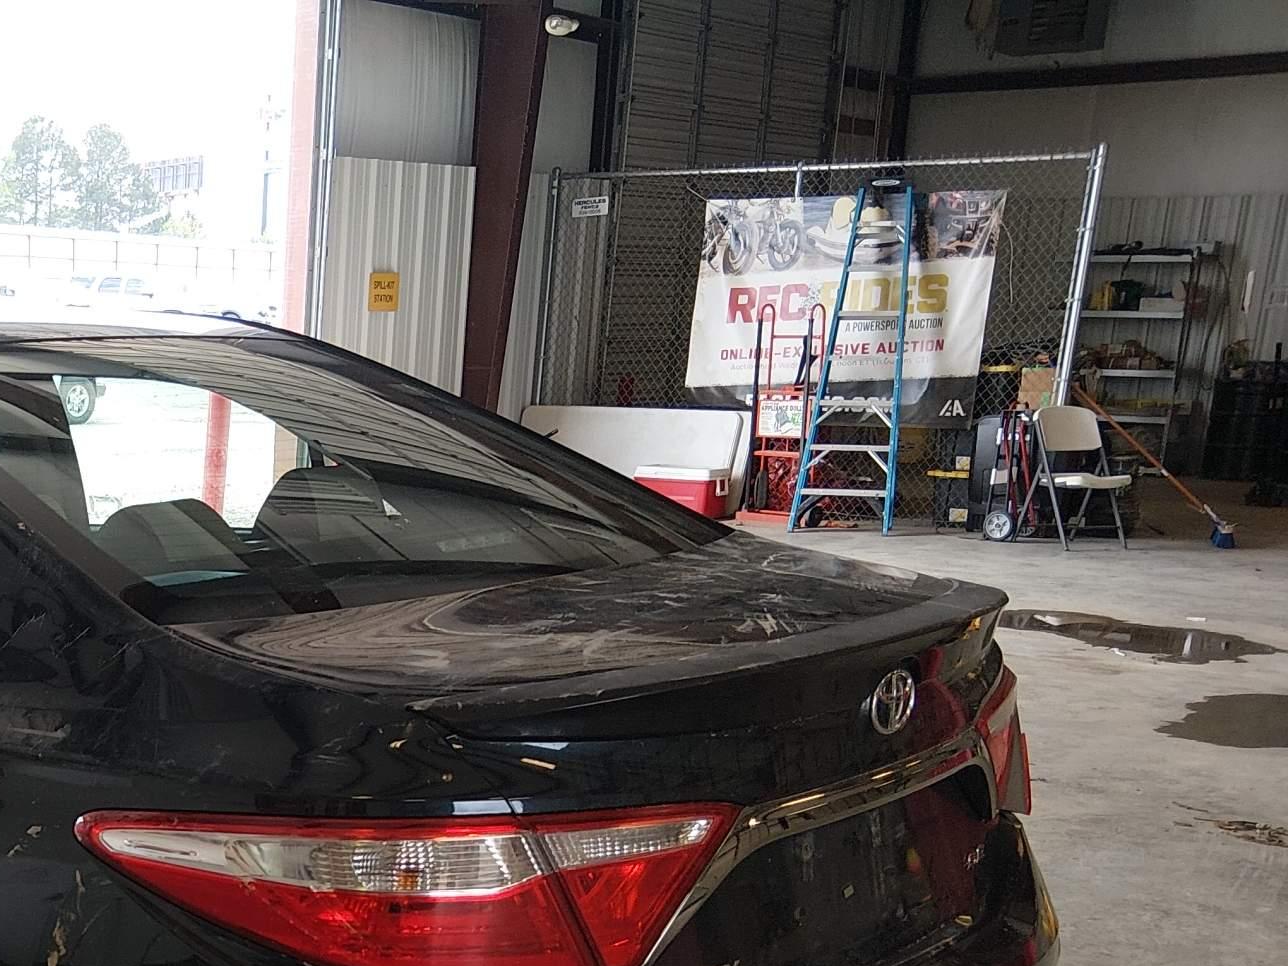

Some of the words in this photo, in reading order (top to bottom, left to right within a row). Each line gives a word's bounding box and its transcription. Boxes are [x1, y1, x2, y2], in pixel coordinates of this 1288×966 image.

[373, 294, 394, 303] STATION
[726, 283, 809, 324] REC
[844, 321, 851, 332] A
[908, 317, 944, 330] AUCTION
